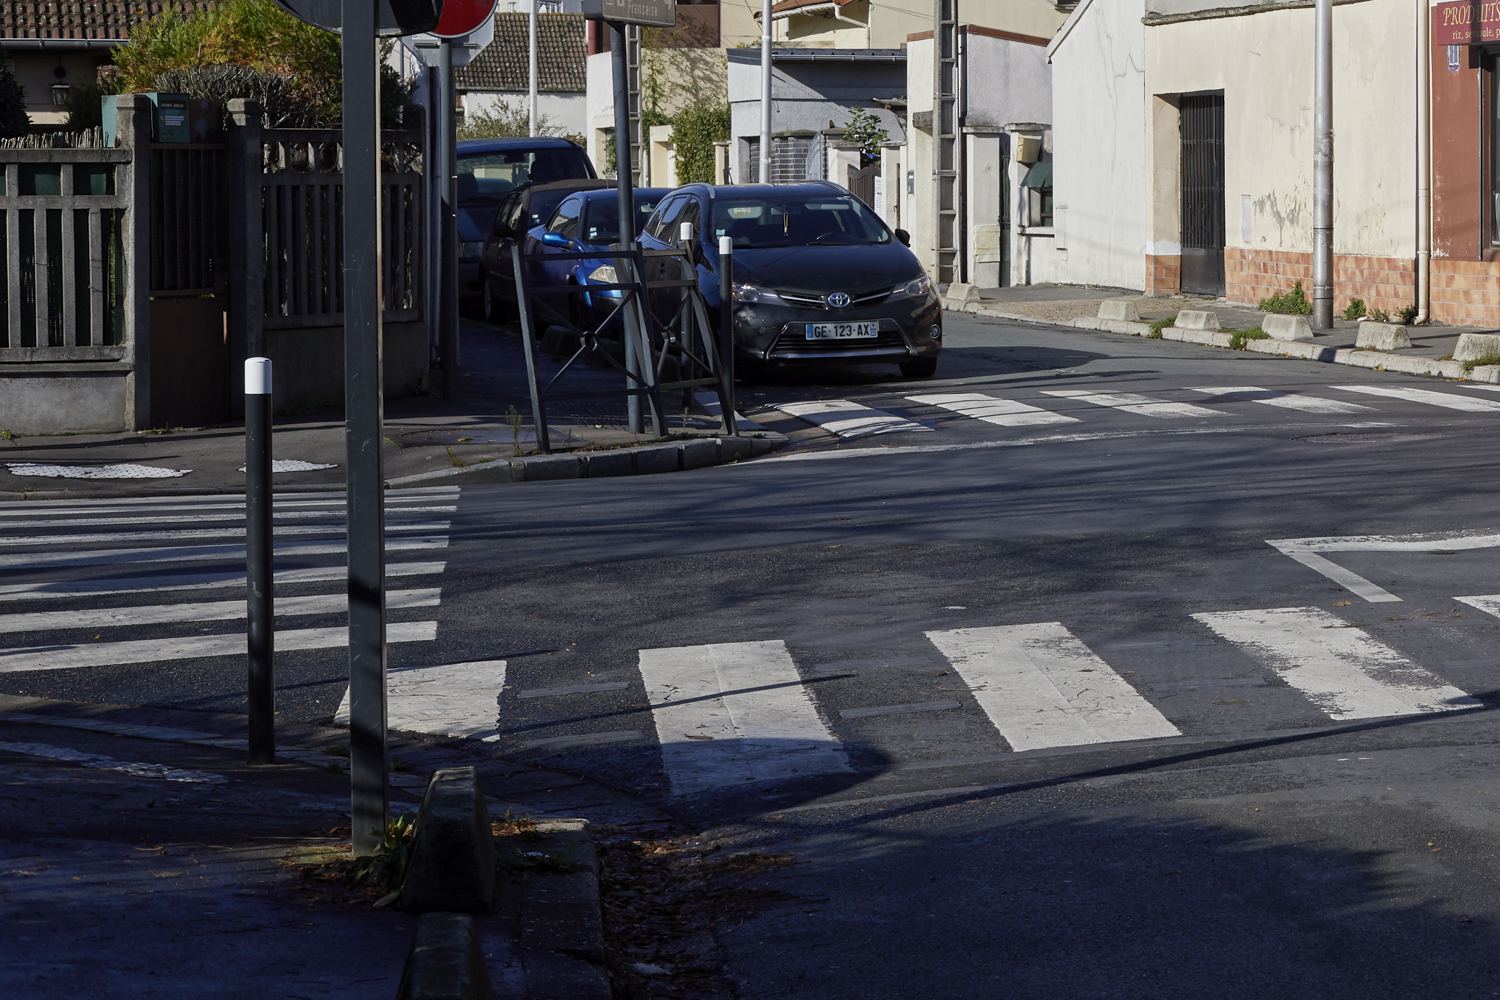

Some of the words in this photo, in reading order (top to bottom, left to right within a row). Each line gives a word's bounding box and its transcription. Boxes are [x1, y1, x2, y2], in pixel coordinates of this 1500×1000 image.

[627, 0, 659, 17] Française
[1452, 30, 1464, 40] riz,
[1465, 26, 1495, 39] semoule,
[814, 323, 870, 338] GE-123-AX
